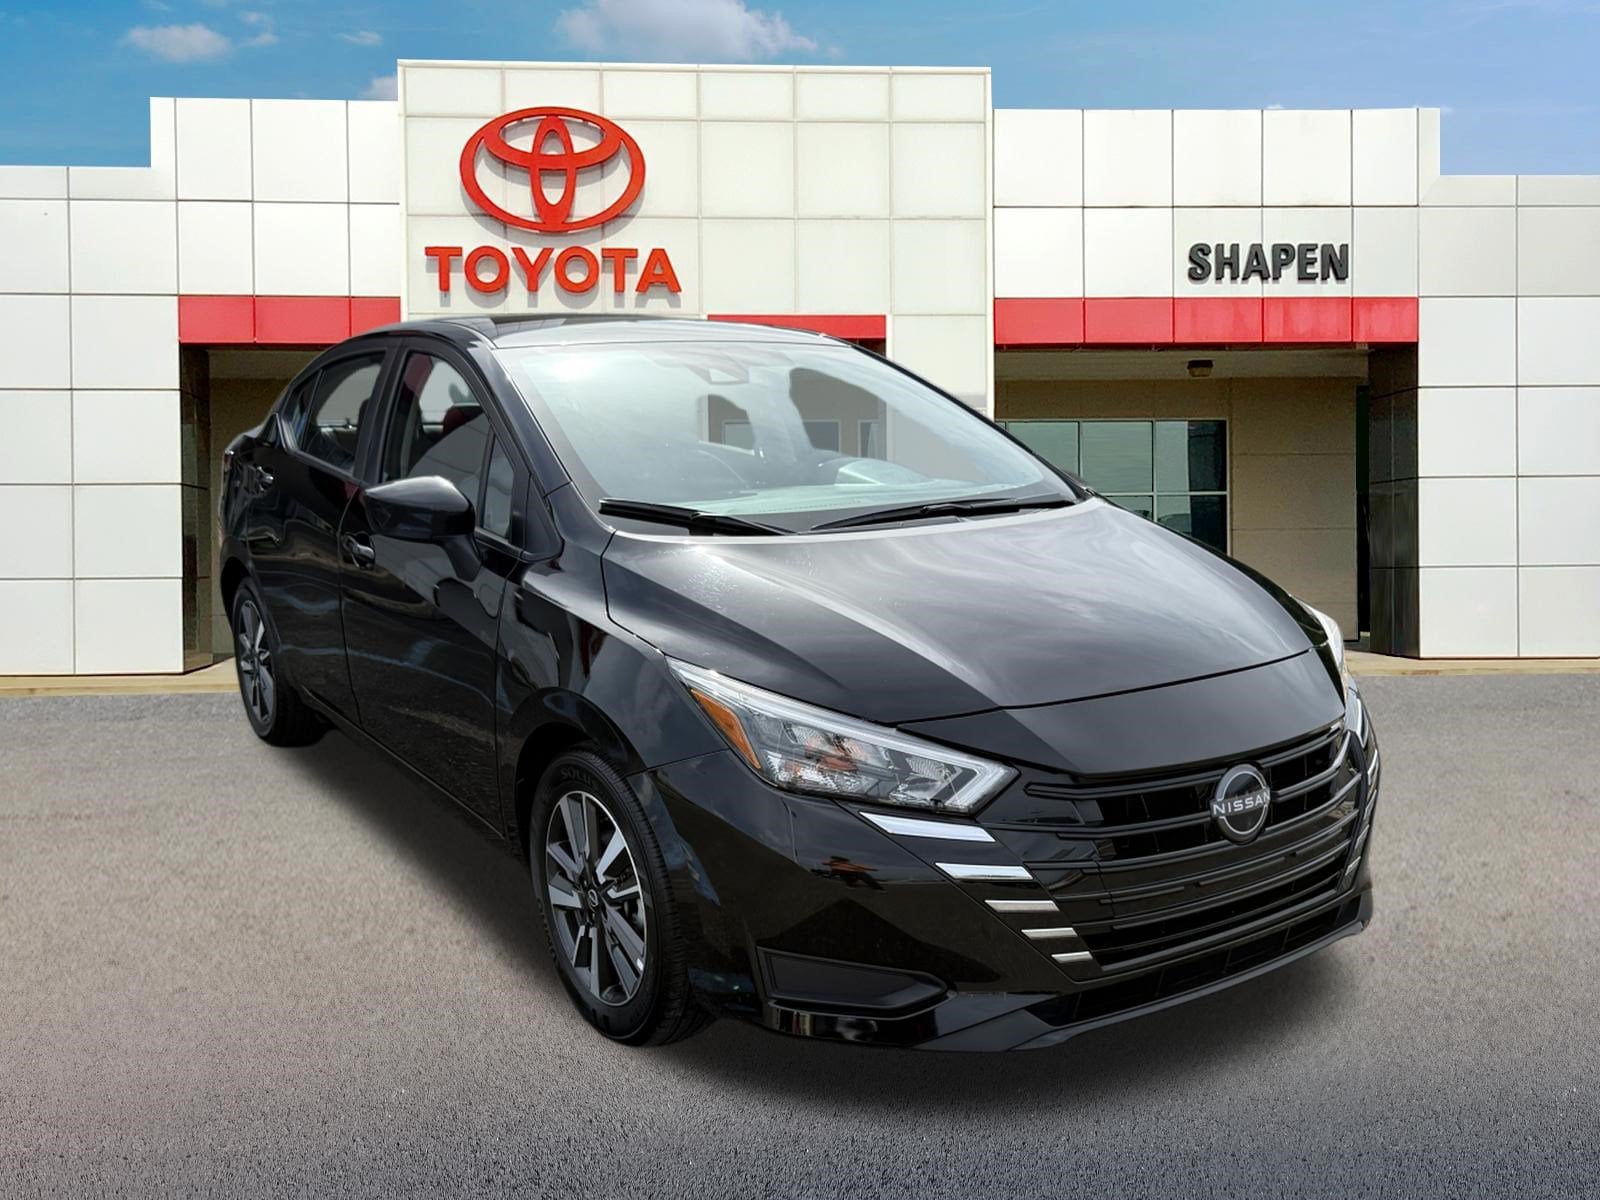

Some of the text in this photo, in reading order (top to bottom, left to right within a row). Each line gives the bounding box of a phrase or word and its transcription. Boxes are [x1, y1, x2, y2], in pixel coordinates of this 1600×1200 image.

[425, 246, 682, 293] TOYOTA
[1188, 243, 1349, 281] SHAPEN
[1213, 791, 1270, 815] NISSAN
